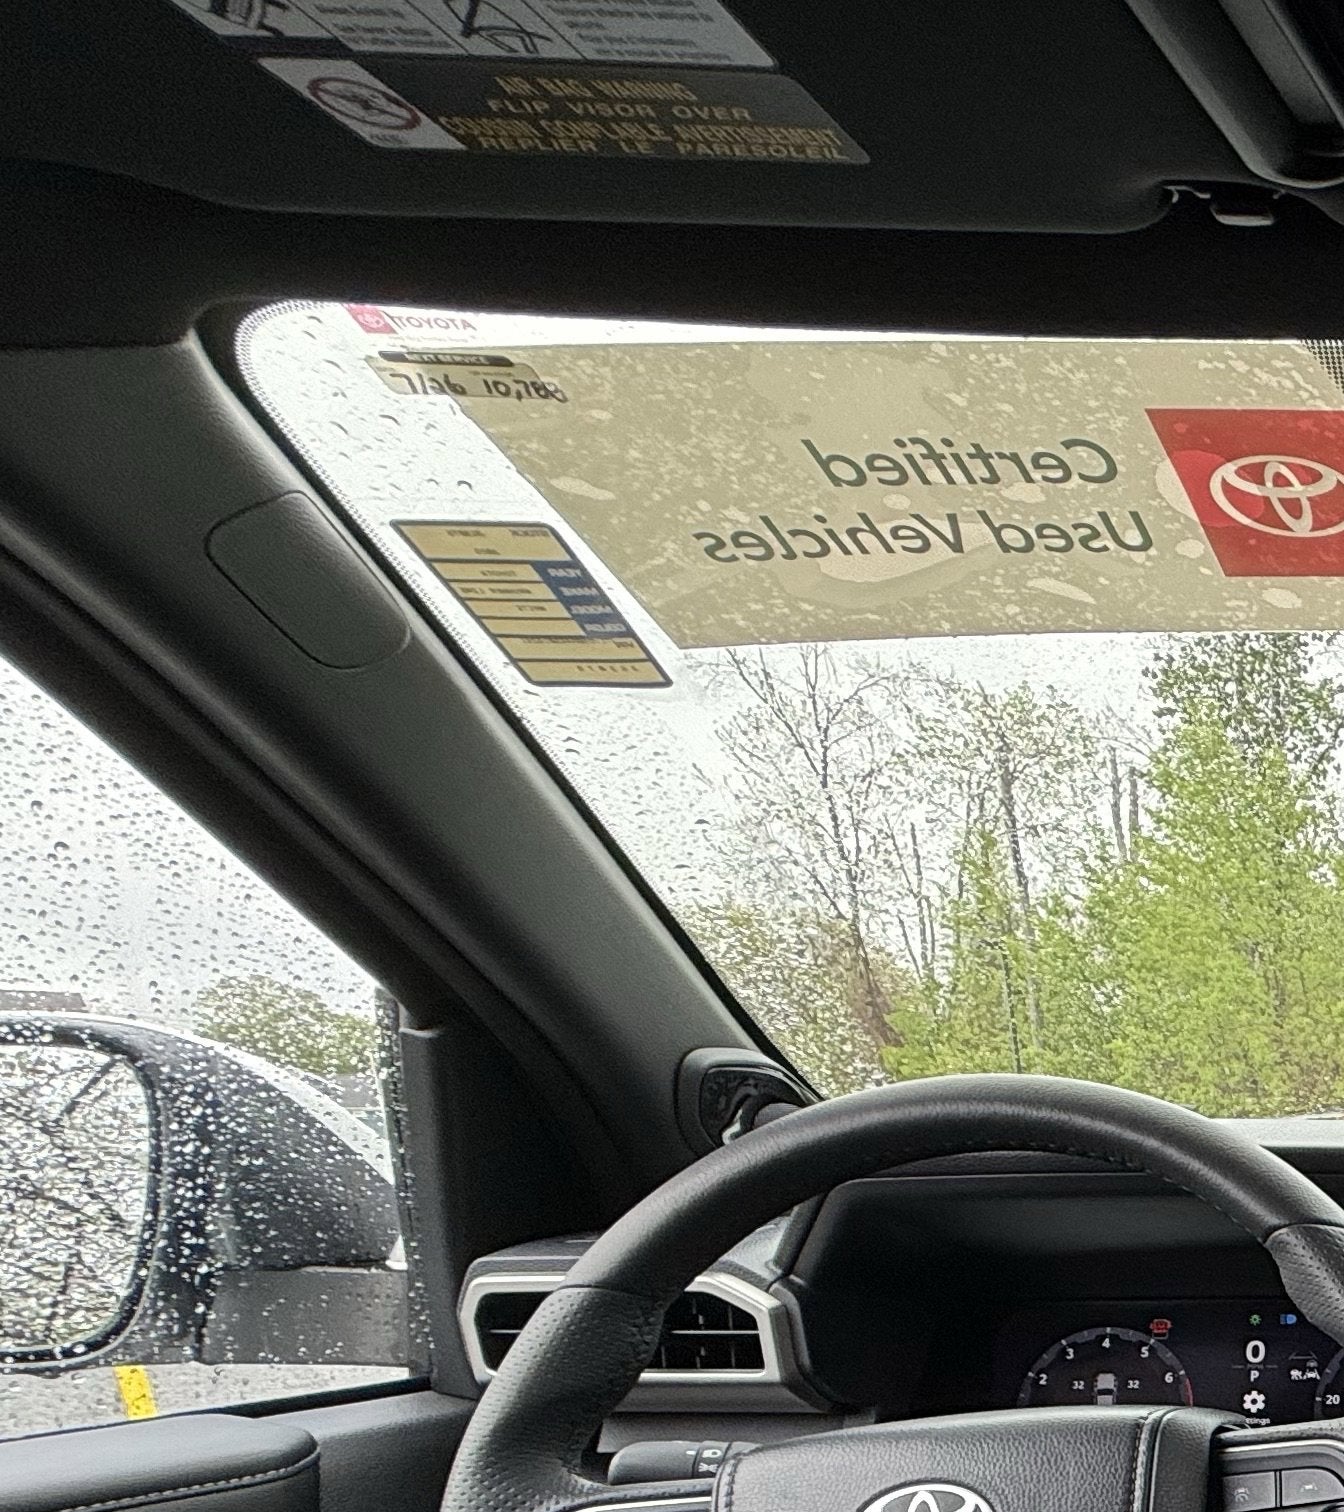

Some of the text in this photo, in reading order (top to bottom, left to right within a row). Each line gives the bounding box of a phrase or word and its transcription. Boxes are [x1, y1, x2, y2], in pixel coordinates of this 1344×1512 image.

[486, 99, 753, 122] FLIP VISOR OVER
[618, 140, 657, 155] LE
[393, 315, 477, 332] TOYOTA
[1101, 1336, 1110, 1349] 4
[1065, 1348, 1075, 1360] 3
[1140, 1347, 1150, 1359] 5
[1244, 1339, 1266, 1364] 0
[1038, 1374, 1049, 1386] 2
[1164, 1372, 1174, 1383] 6
[1249, 1370, 1260, 1383] P
[1072, 1380, 1085, 1390] 32
[1127, 1379, 1140, 1390] 32
[1325, 1394, 1341, 1405] 20
